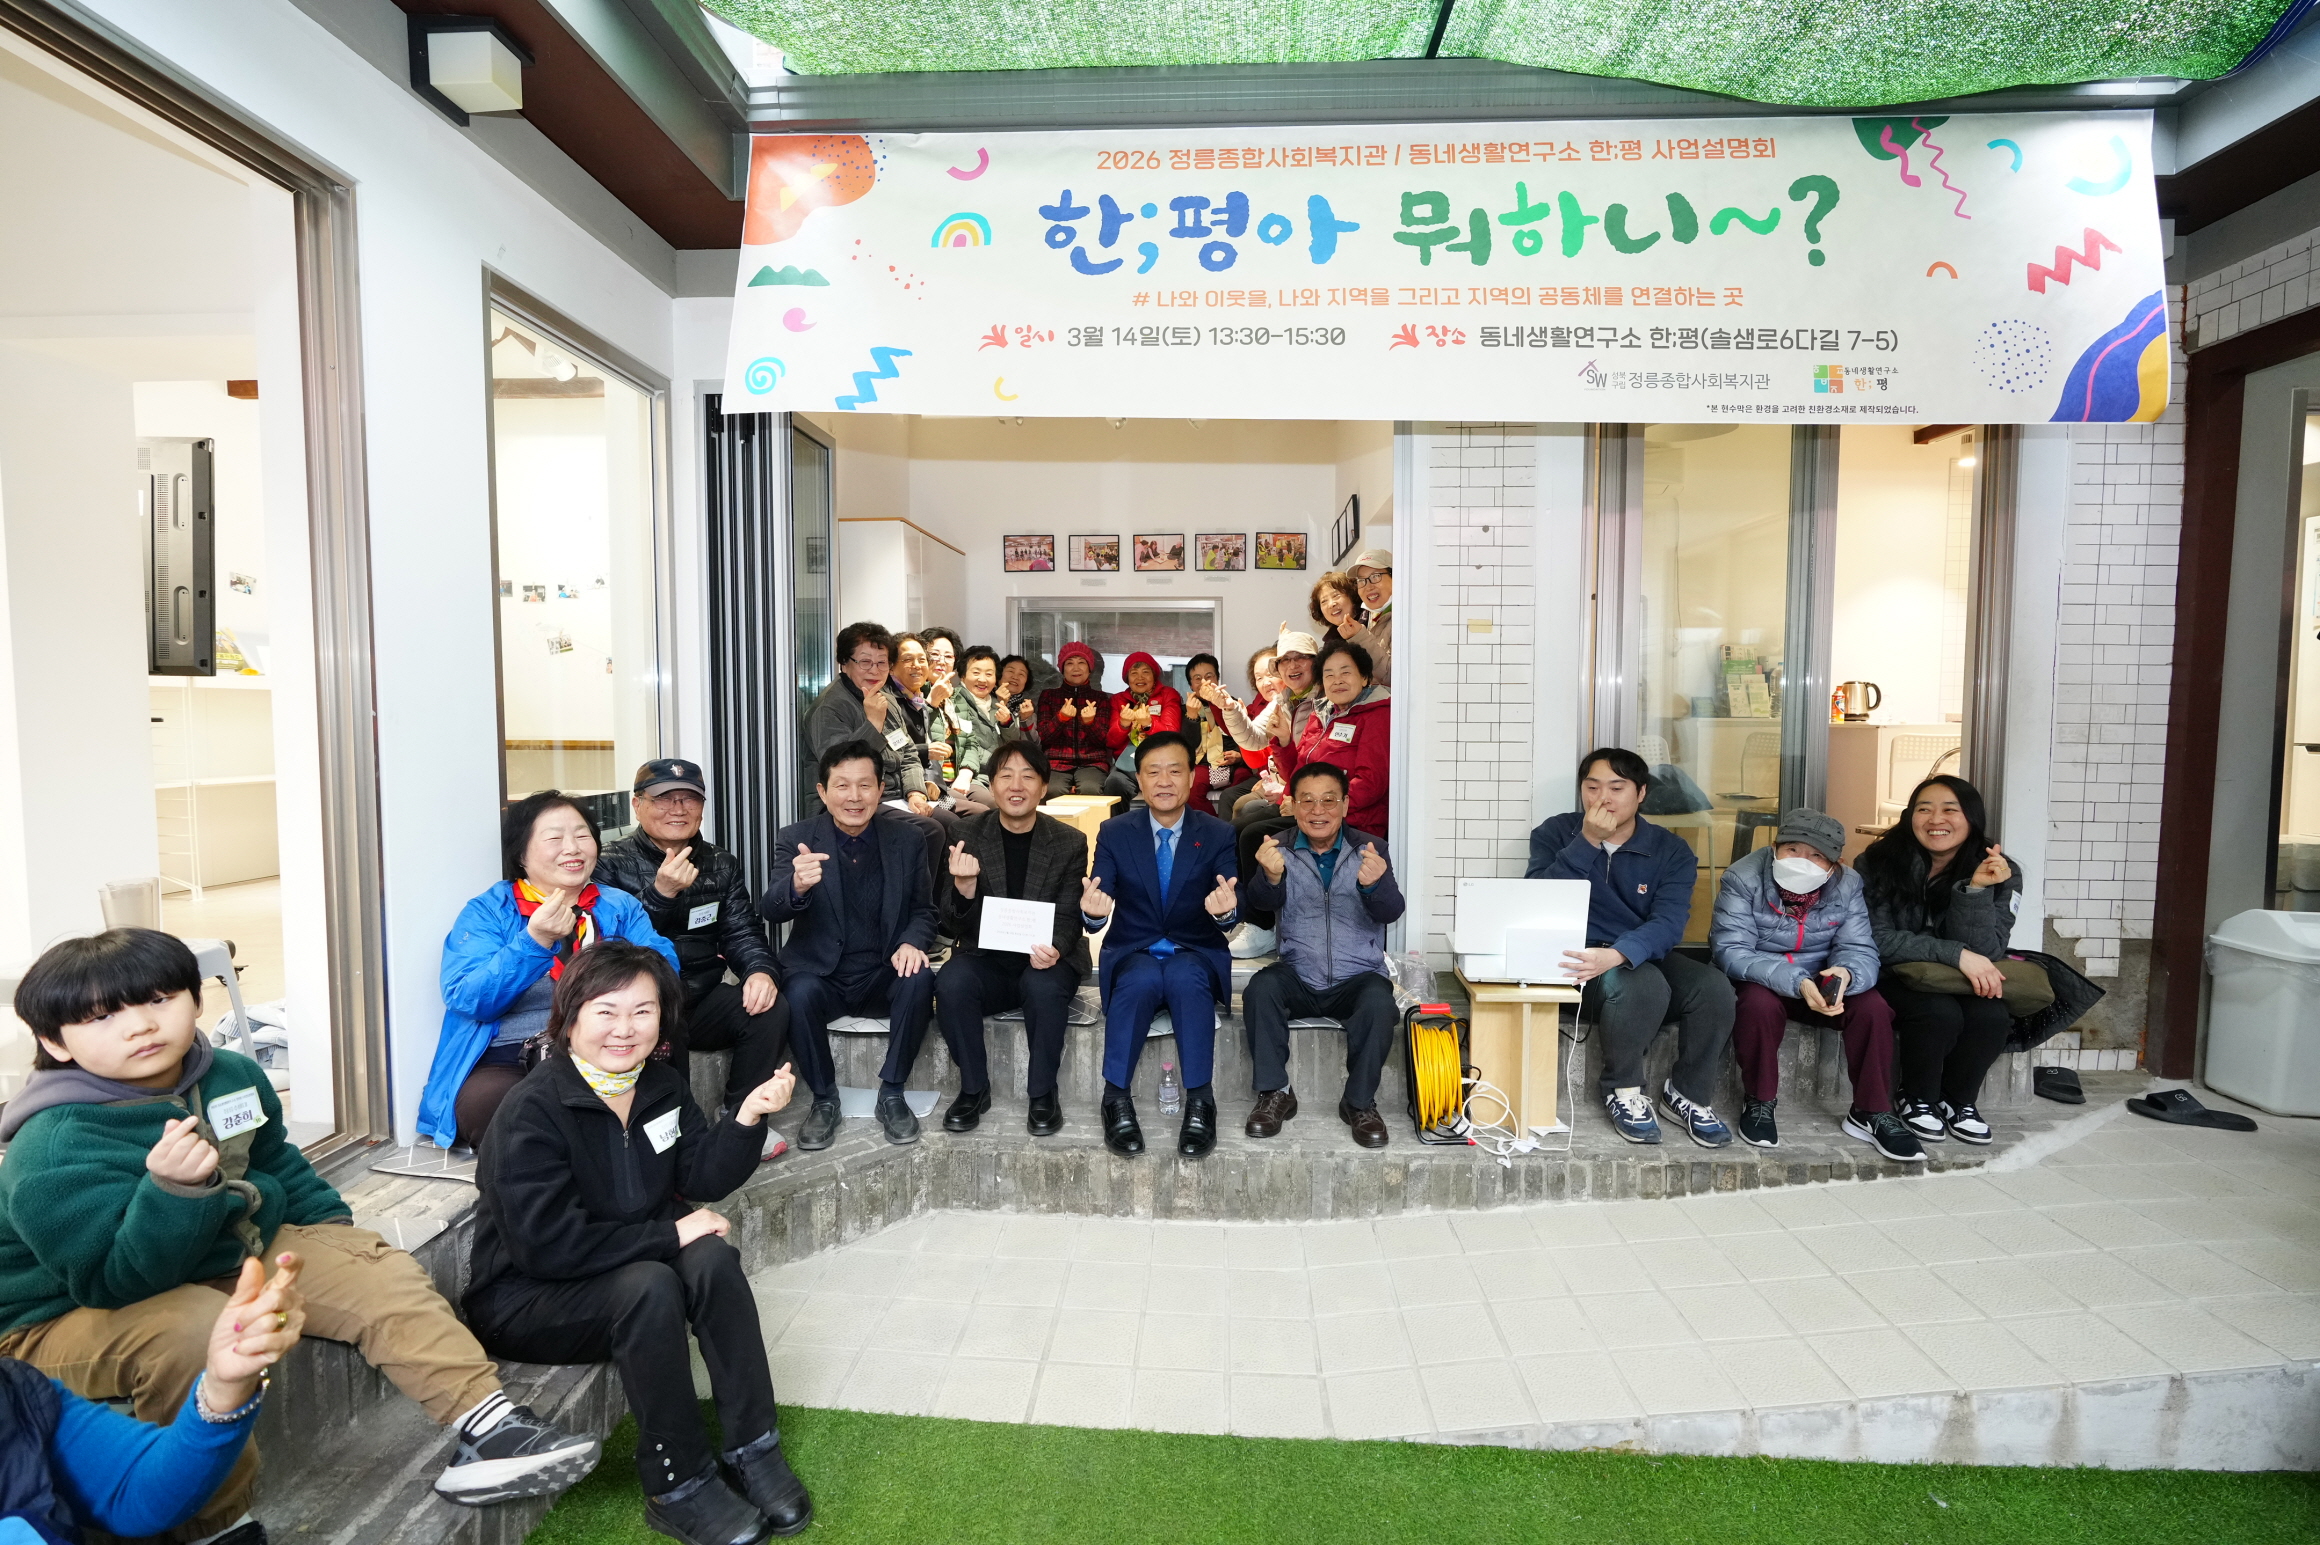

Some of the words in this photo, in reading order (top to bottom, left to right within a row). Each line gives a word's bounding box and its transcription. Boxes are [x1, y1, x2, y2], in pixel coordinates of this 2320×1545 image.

[1097, 151, 1160, 169] 2026
[1169, 145, 1387, 170] 정릉종합사회복지관
[1409, 141, 1581, 165] 동네생활연구소
[1589, 140, 1642, 161] 한;평
[1651, 138, 1777, 161] 사업설명회
[1039, 189, 1360, 275] 한;평아
[1132, 292, 1151, 307] #
[1158, 291, 1199, 308] 나와
[1206, 290, 1272, 309] 이웃을,
[1279, 289, 1321, 307] 나와
[1328, 288, 1391, 307] 지역을
[1398, 288, 1461, 306] 그리고
[1468, 287, 1531, 306] 지역의
[1539, 286, 1624, 307] 공동체를
[1631, 286, 1717, 307] 연결하는
[1723, 288, 1744, 307] 곳
[1015, 325, 1055, 349] 일시
[1068, 326, 1104, 348] 3월
[1112, 326, 1201, 347] 14일(토)
[1209, 327, 1346, 346] 13:30-15:30
[1425, 325, 1467, 348] 장소
[1480, 326, 1643, 349] 동네생활연구소
[1650, 327, 1840, 352] 한;평(솔샘로6다길
[1848, 330, 1899, 353] 7-5)
[1586, 369, 1608, 388] SW
[1612, 372, 1627, 381] 성북
[1844, 367, 1899, 376] 동네생활연구소
[1612, 381, 1626, 390] 구립
[1629, 372, 1771, 391] 정릉종합사회복지관
[1722, 405, 1753, 414] 현수막은
[1756, 405, 1780, 414] 환경을
[1782, 405, 1806, 414] 고려한
[1809, 405, 1857, 414] 친환경소재로
[1860, 405, 1919, 415] 제작되었습니다.
[222, 1110, 253, 1129] 강준희
